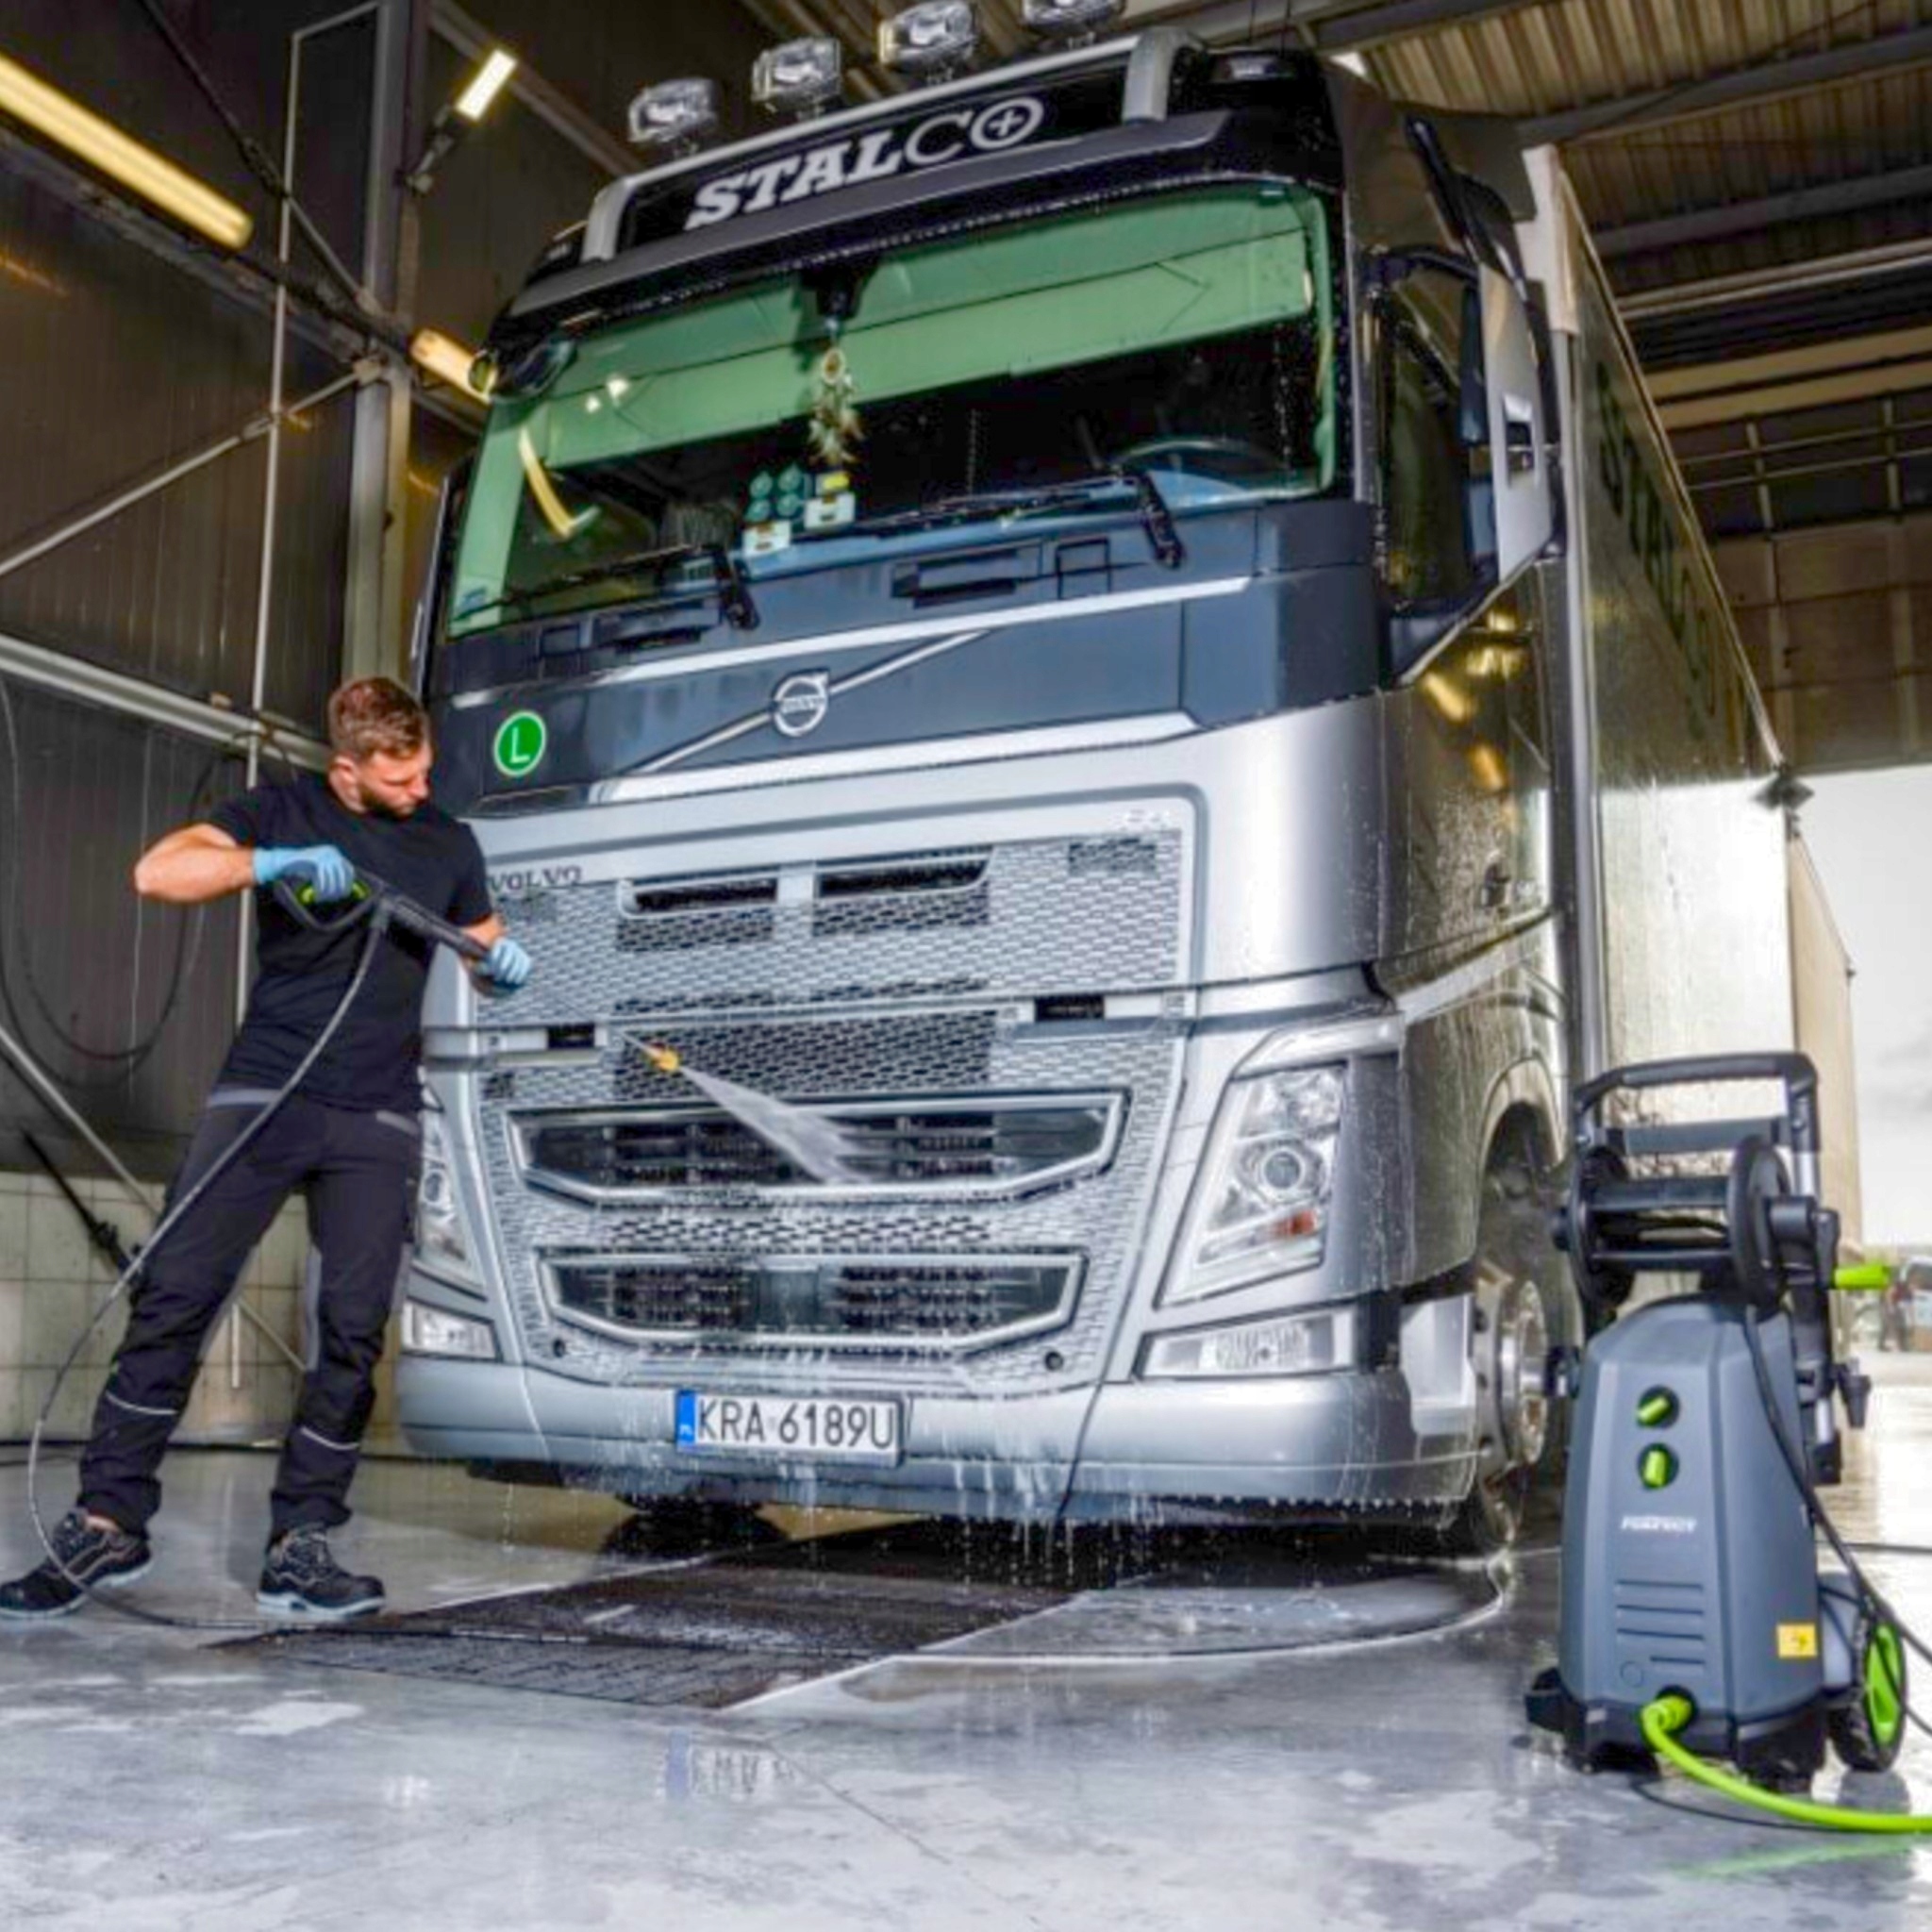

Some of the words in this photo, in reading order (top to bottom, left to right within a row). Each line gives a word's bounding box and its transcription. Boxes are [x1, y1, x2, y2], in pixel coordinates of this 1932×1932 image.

[684, 97, 1043, 230] STALCO
[510, 725, 530, 763] L
[487, 865, 582, 892] VOLVO
[698, 1398, 765, 1441] KRA
[779, 1402, 894, 1449] 6189U
